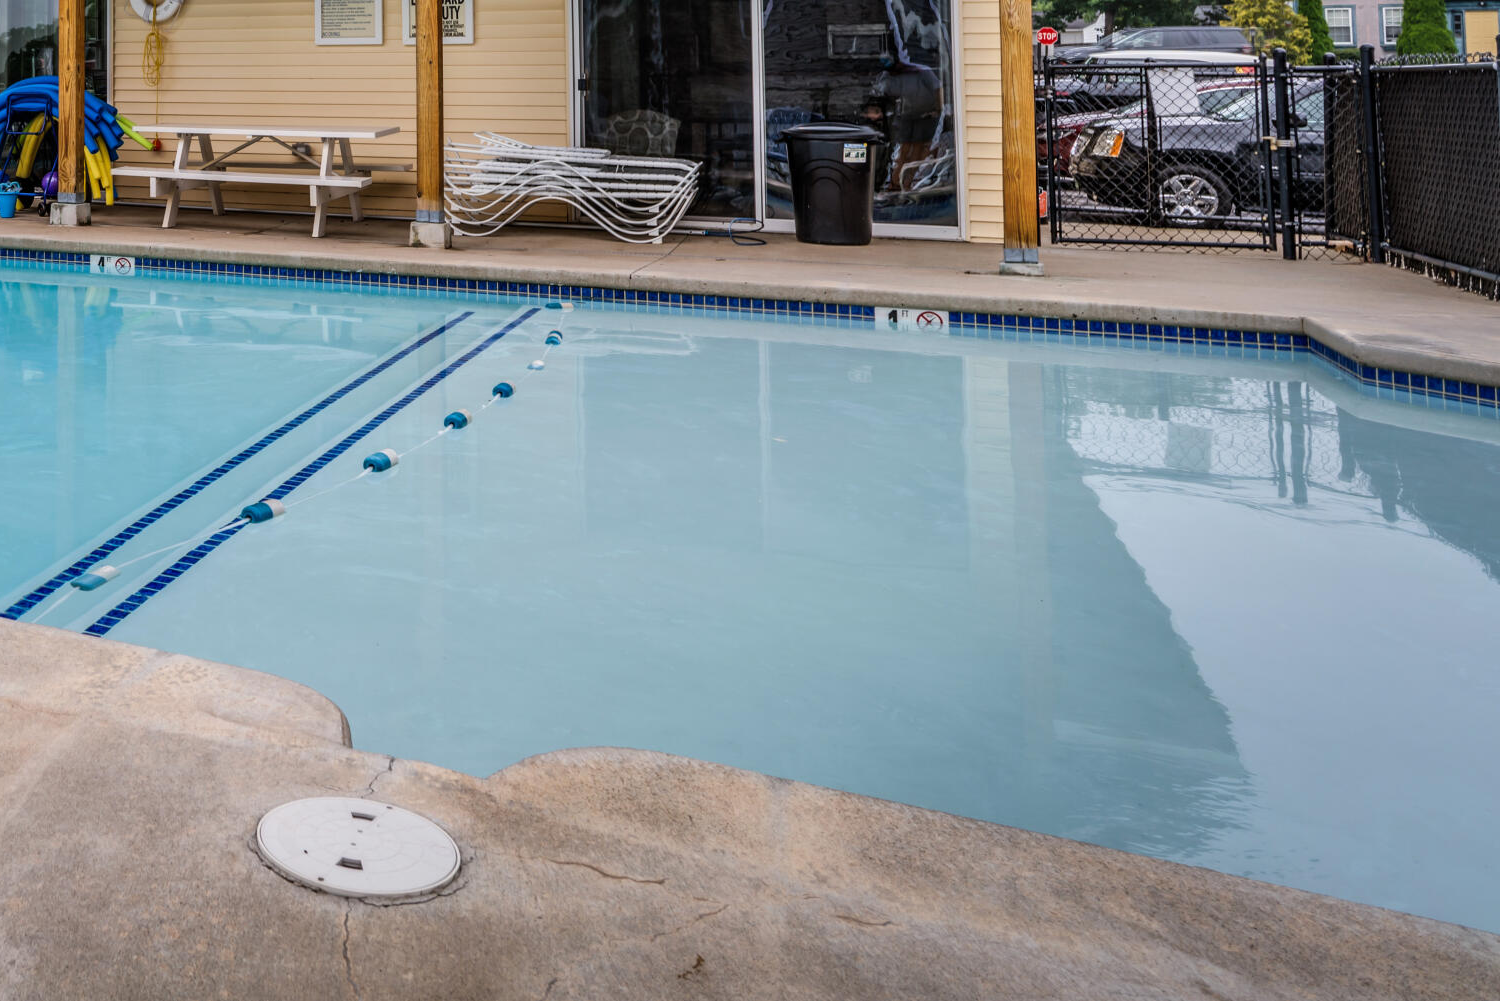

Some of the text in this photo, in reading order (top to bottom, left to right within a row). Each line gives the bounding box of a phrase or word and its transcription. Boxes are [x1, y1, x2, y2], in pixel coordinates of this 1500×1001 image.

[442, 6, 460, 19] UTY
[1038, 32, 1057, 40] STOP
[901, 309, 909, 317] FT
